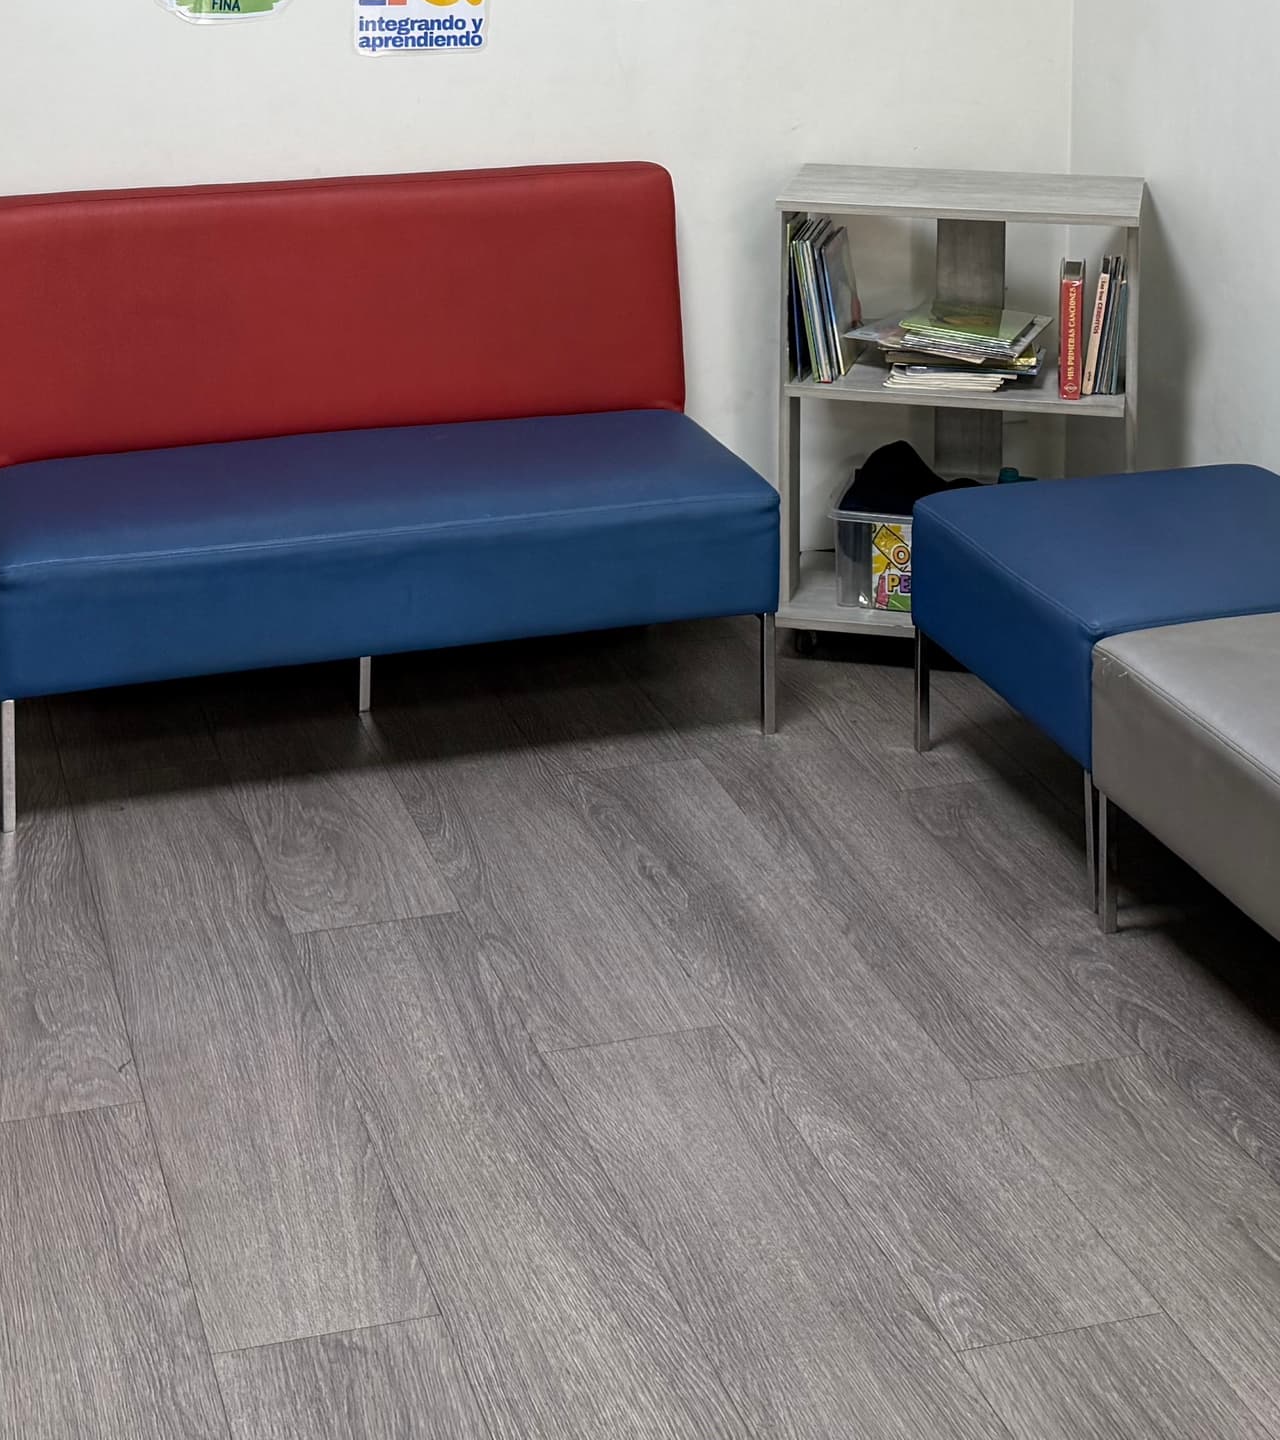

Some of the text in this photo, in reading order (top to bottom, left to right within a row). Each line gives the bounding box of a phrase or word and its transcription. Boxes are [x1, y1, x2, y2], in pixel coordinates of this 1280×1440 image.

[358, 14, 483, 35] integrando y
[358, 31, 483, 51] aprendiendo
[1069, 287, 1077, 326] CANCIONES
